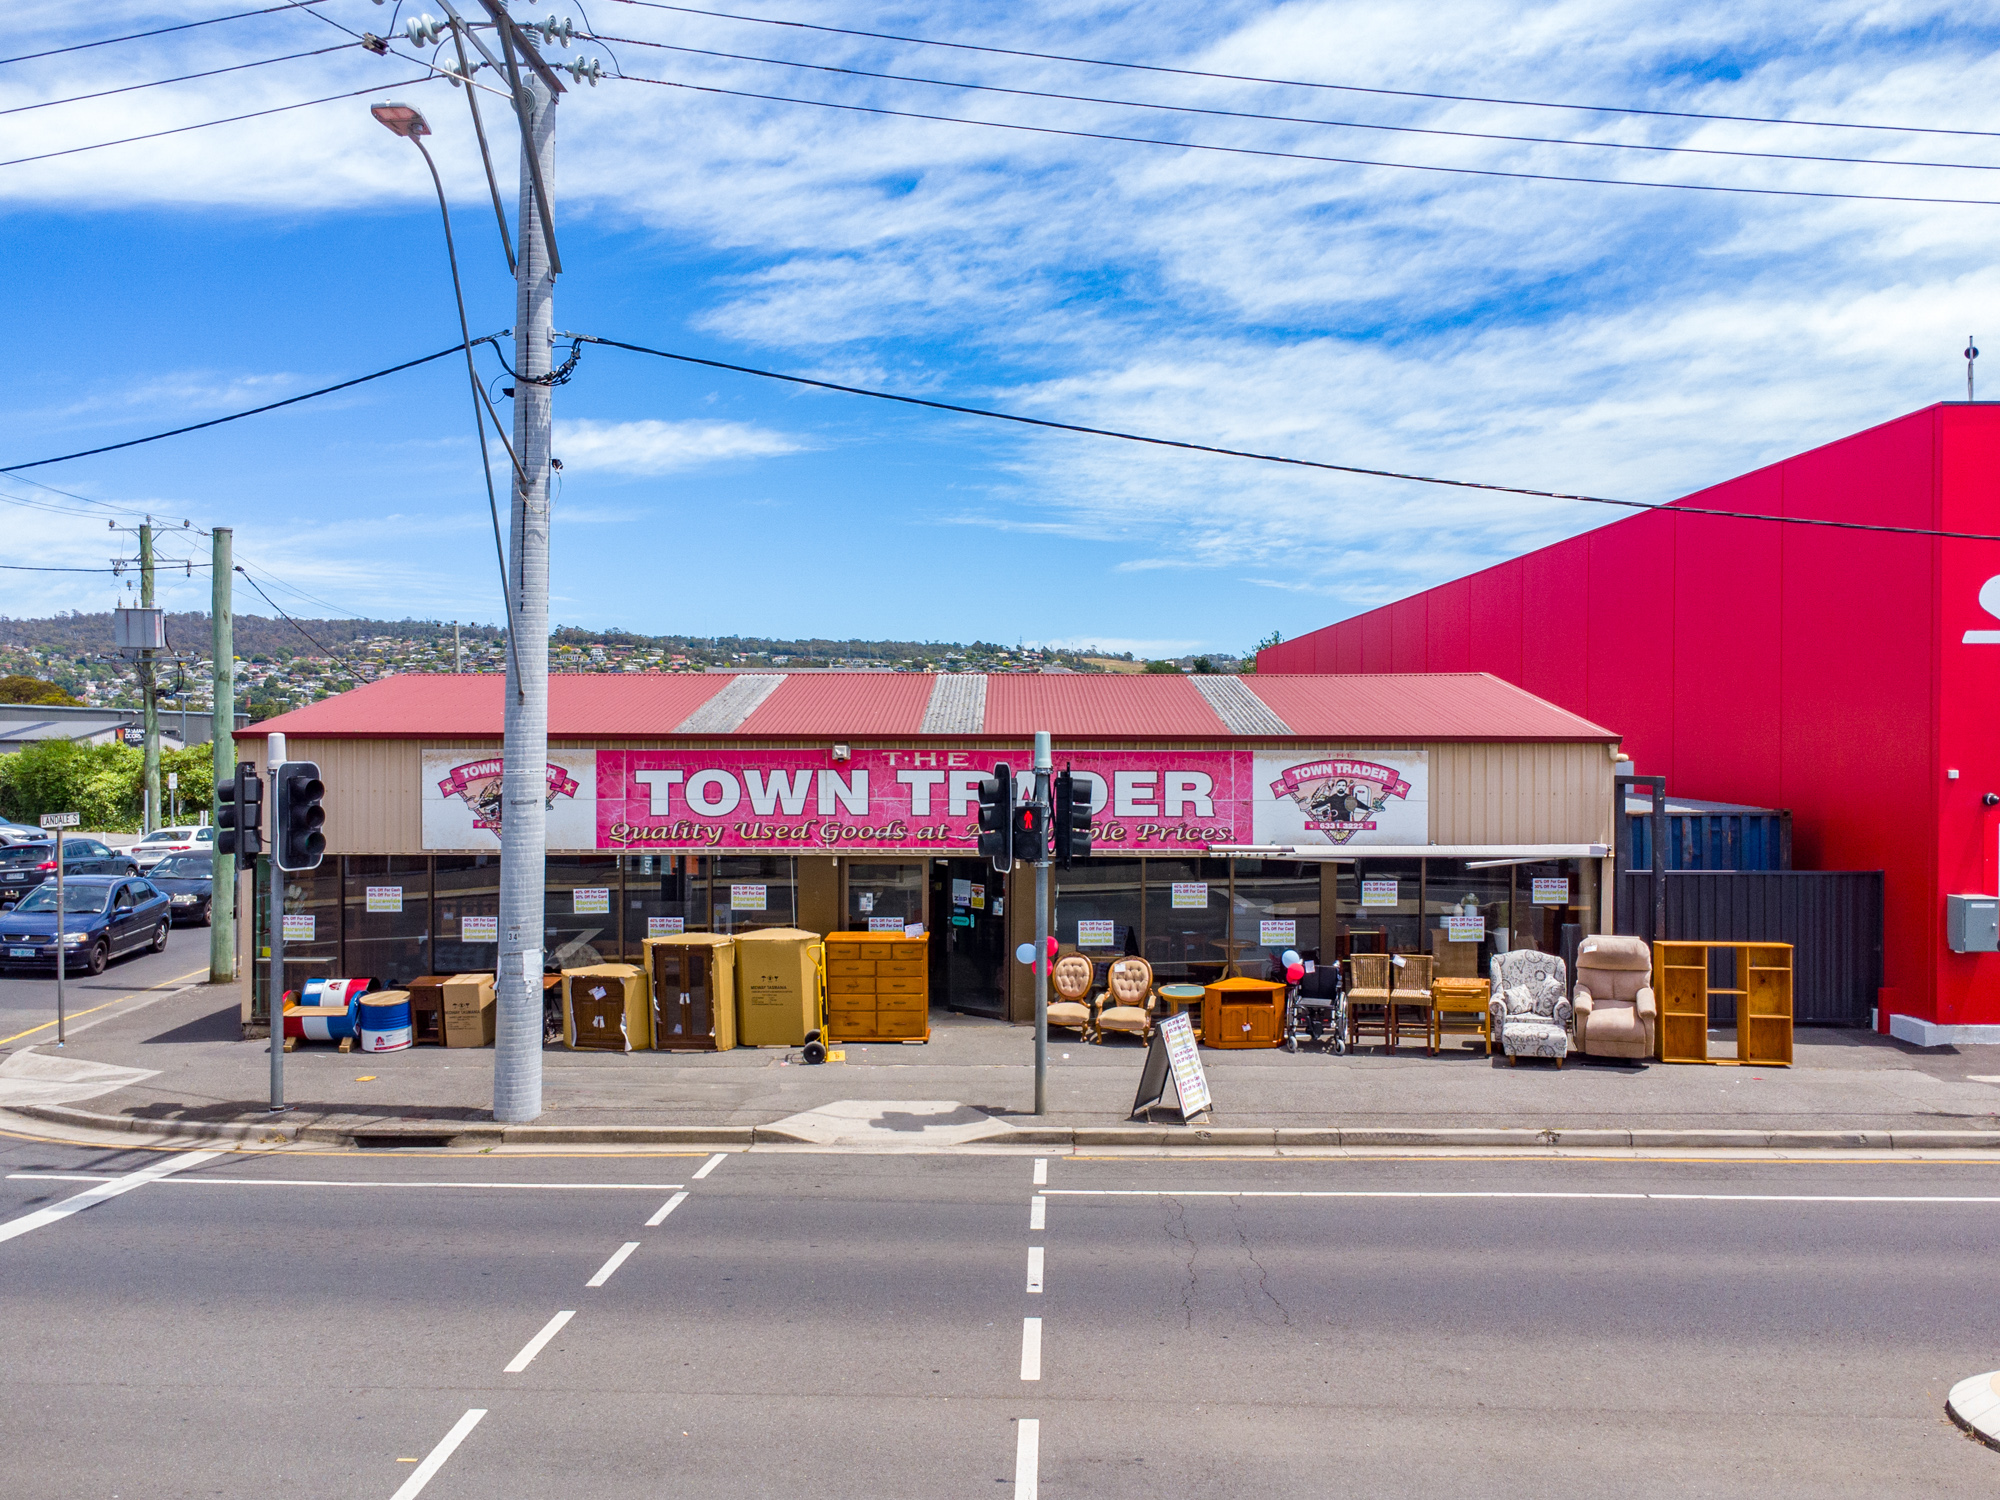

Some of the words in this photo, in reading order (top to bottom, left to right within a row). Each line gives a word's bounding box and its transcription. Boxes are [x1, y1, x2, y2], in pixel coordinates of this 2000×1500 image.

[461, 762, 500, 779] TOWN
[1292, 763, 1332, 780] TOWN
[1335, 763, 1389, 780] TRADER
[635, 768, 870, 817] TOWN
[42, 815, 70, 826] LANDALE
[608, 819, 724, 846] Quality
[734, 819, 820, 841] Used
[819, 819, 909, 843] Goods
[916, 823, 950, 841] at
[1136, 822, 1237, 843] Prices.
